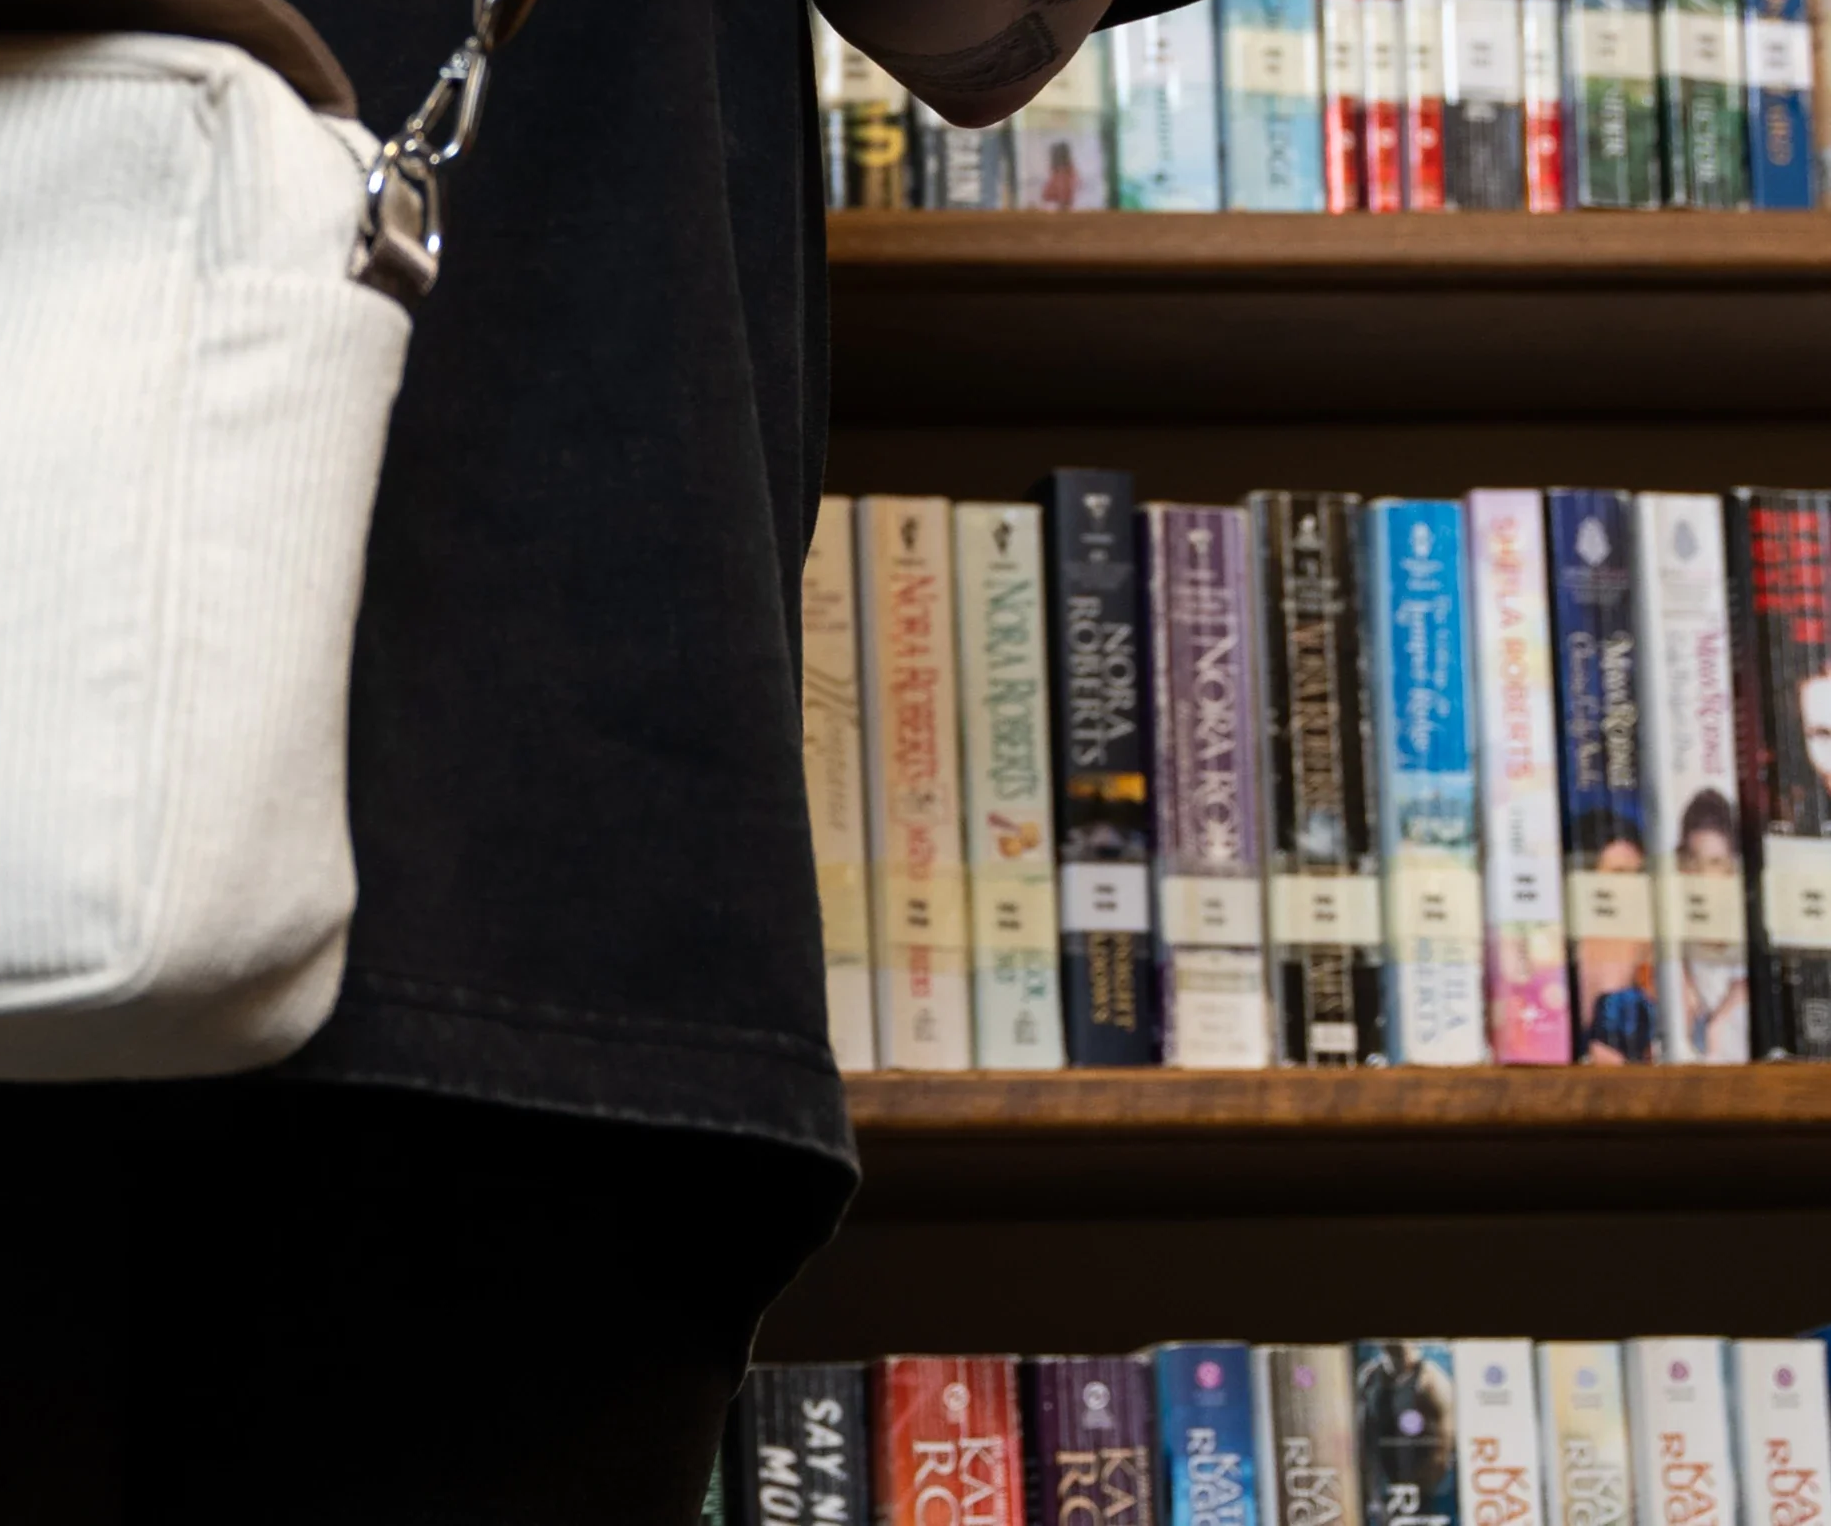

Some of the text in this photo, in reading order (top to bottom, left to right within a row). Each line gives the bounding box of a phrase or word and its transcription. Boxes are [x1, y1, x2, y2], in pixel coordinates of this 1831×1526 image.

[888, 573, 943, 786] NORA ROBERTS
[982, 577, 1041, 800] NORA ROBERTS
[1065, 596, 1105, 766] ROBERTS
[1099, 622, 1135, 741] NORA
[1189, 621, 1240, 762] NORA
[1490, 515, 1536, 781] SHEILA ROBERTS
[801, 1399, 848, 1479] SAY
[1470, 1436, 1506, 1526] RUG
[1562, 1436, 1597, 1526] RUG
[1659, 1431, 1692, 1526] RUG
